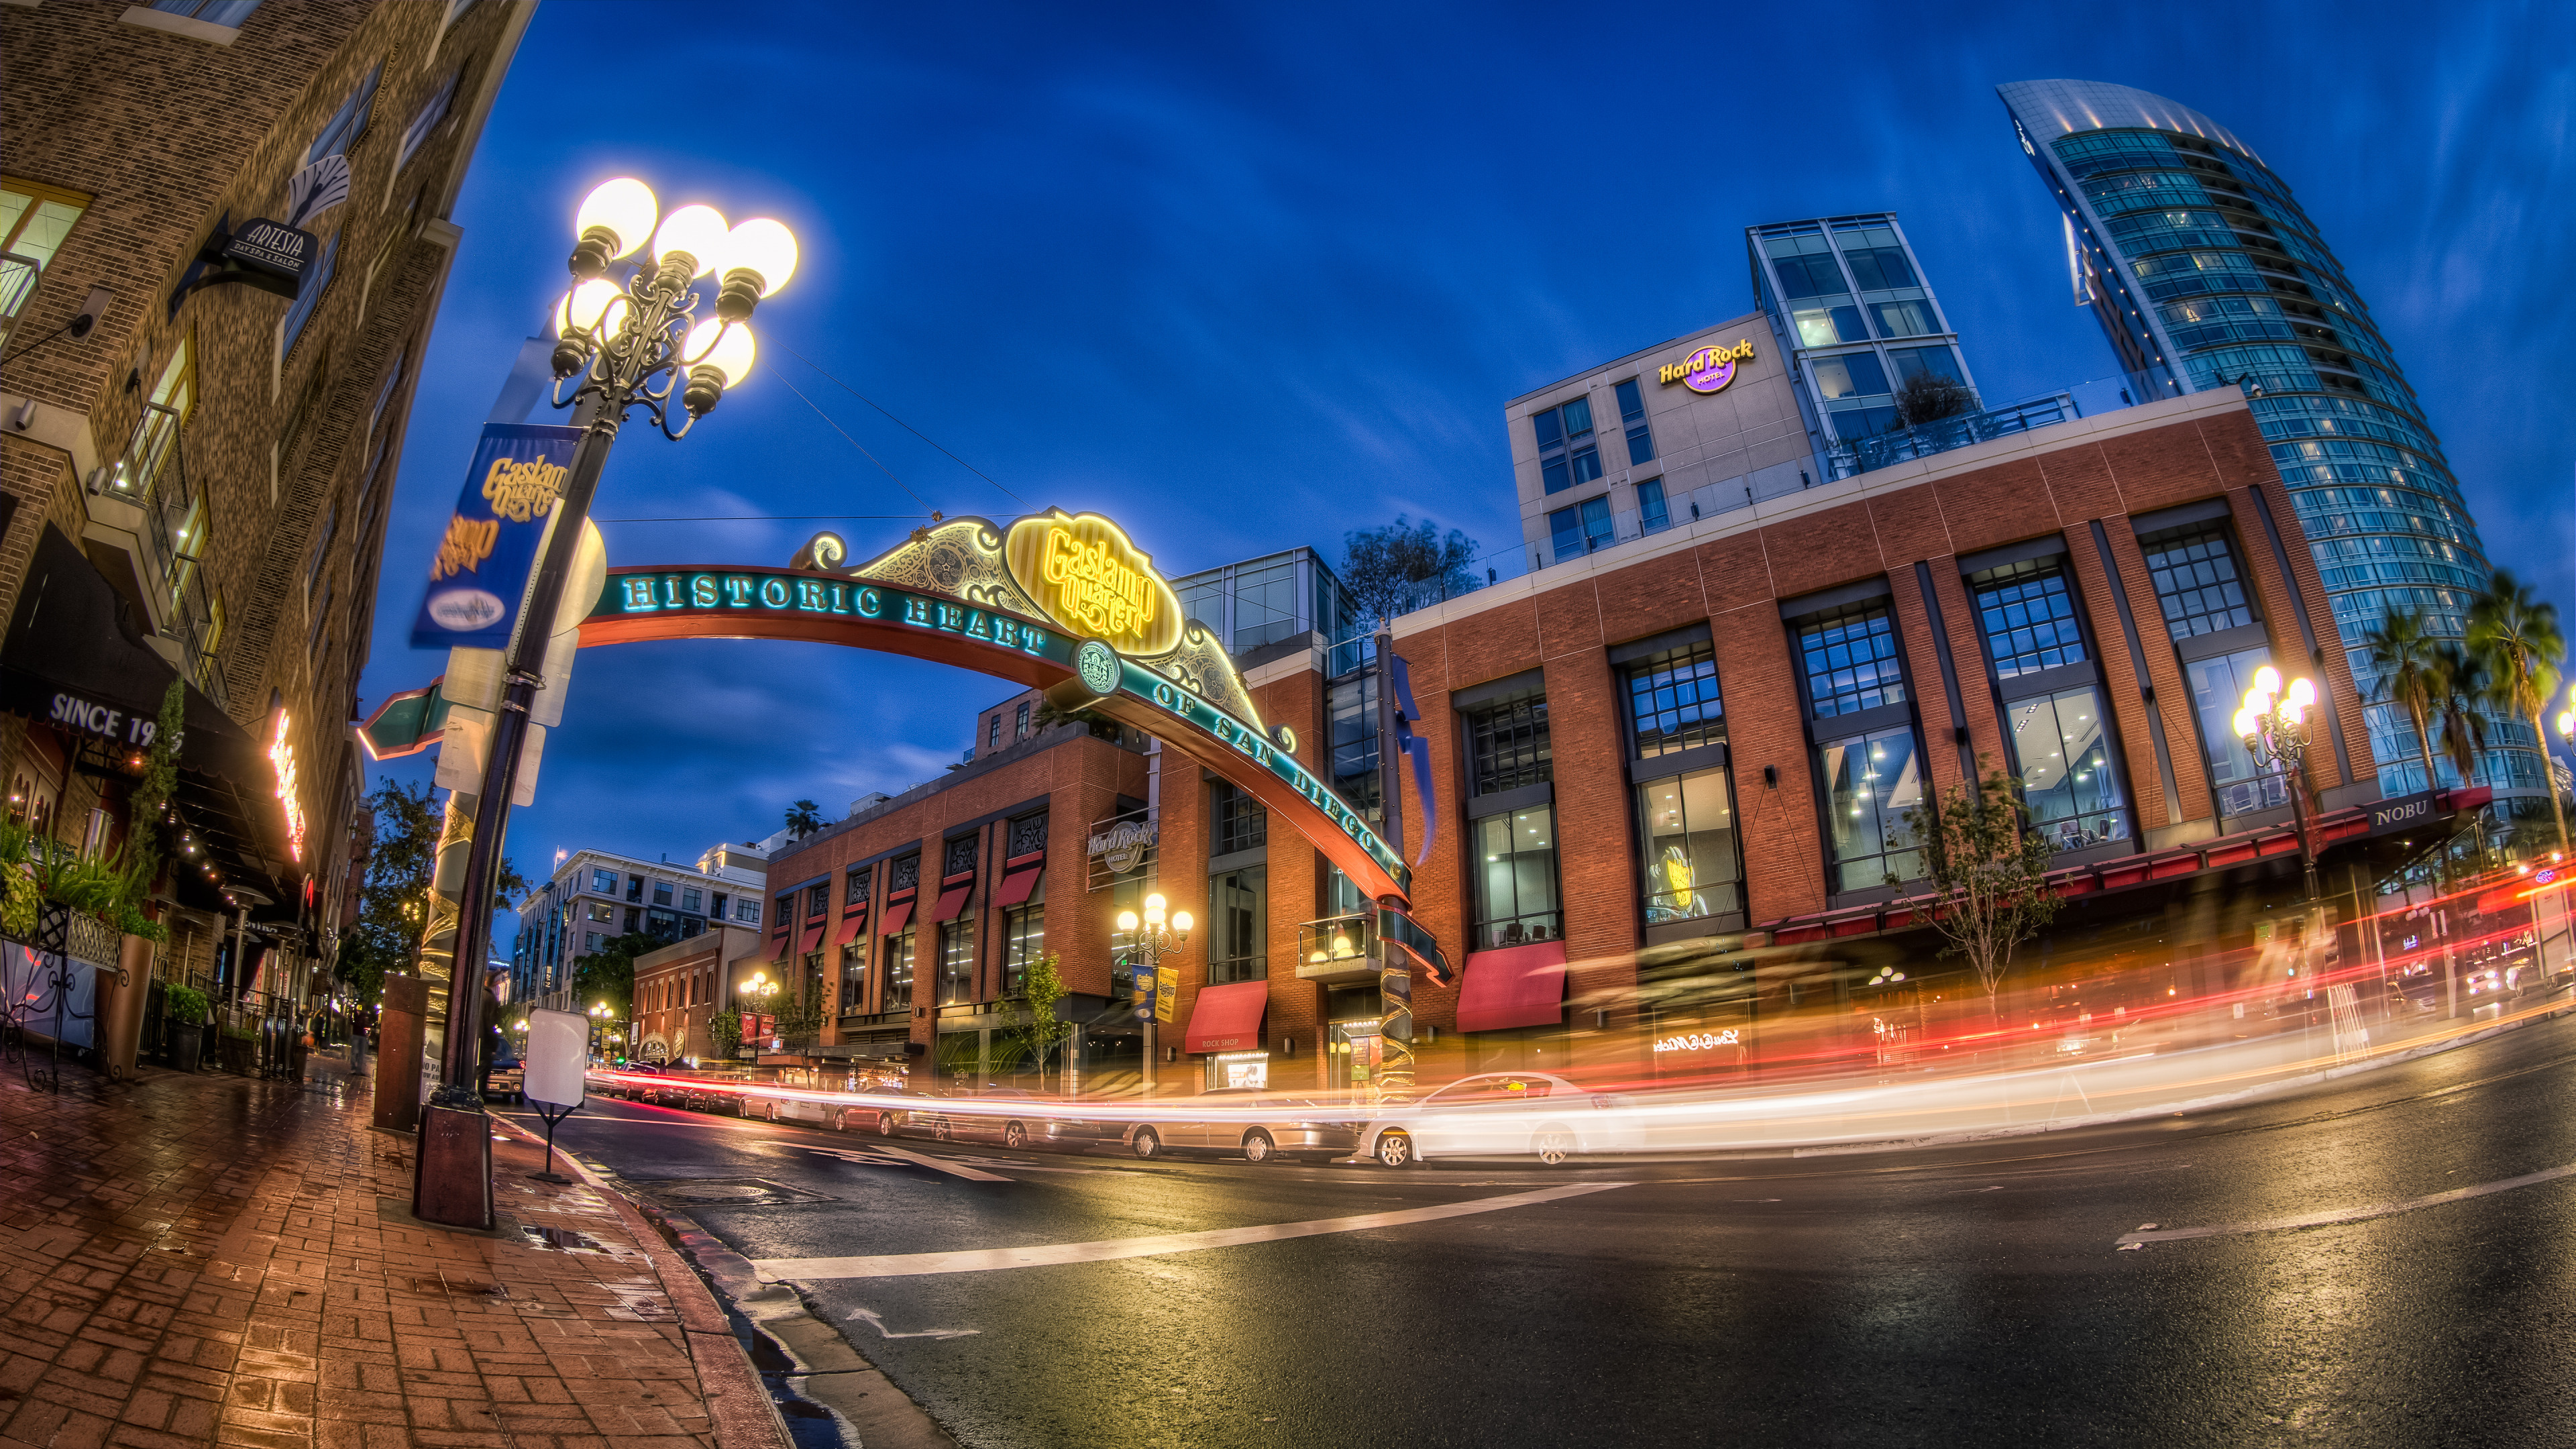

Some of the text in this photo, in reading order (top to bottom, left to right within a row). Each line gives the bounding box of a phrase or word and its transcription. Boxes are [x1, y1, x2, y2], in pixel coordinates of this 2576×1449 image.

[234, 243, 250, 252] DAY
[250, 248, 264, 257] SPA
[273, 255, 300, 268] SALON
[247, 224, 304, 256] ARTESIA
[1658, 339, 1756, 384] Hard Rock
[1697, 371, 1725, 384] HOTEL
[482, 454, 568, 500] Gaslam
[1044, 527, 1155, 622] Gaslamp
[1061, 574, 1142, 640] Quarter
[50, 693, 185, 754] SINCE 195
[624, 575, 1375, 850] HISTORIC HEART OF SAN DIEGO
[2375, 800, 2428, 826] NOBU
[1087, 823, 1152, 856] Hard Rock
[1108, 853, 1128, 863] HOTEL
[1202, 1038, 1239, 1048] ROCK SHOP
